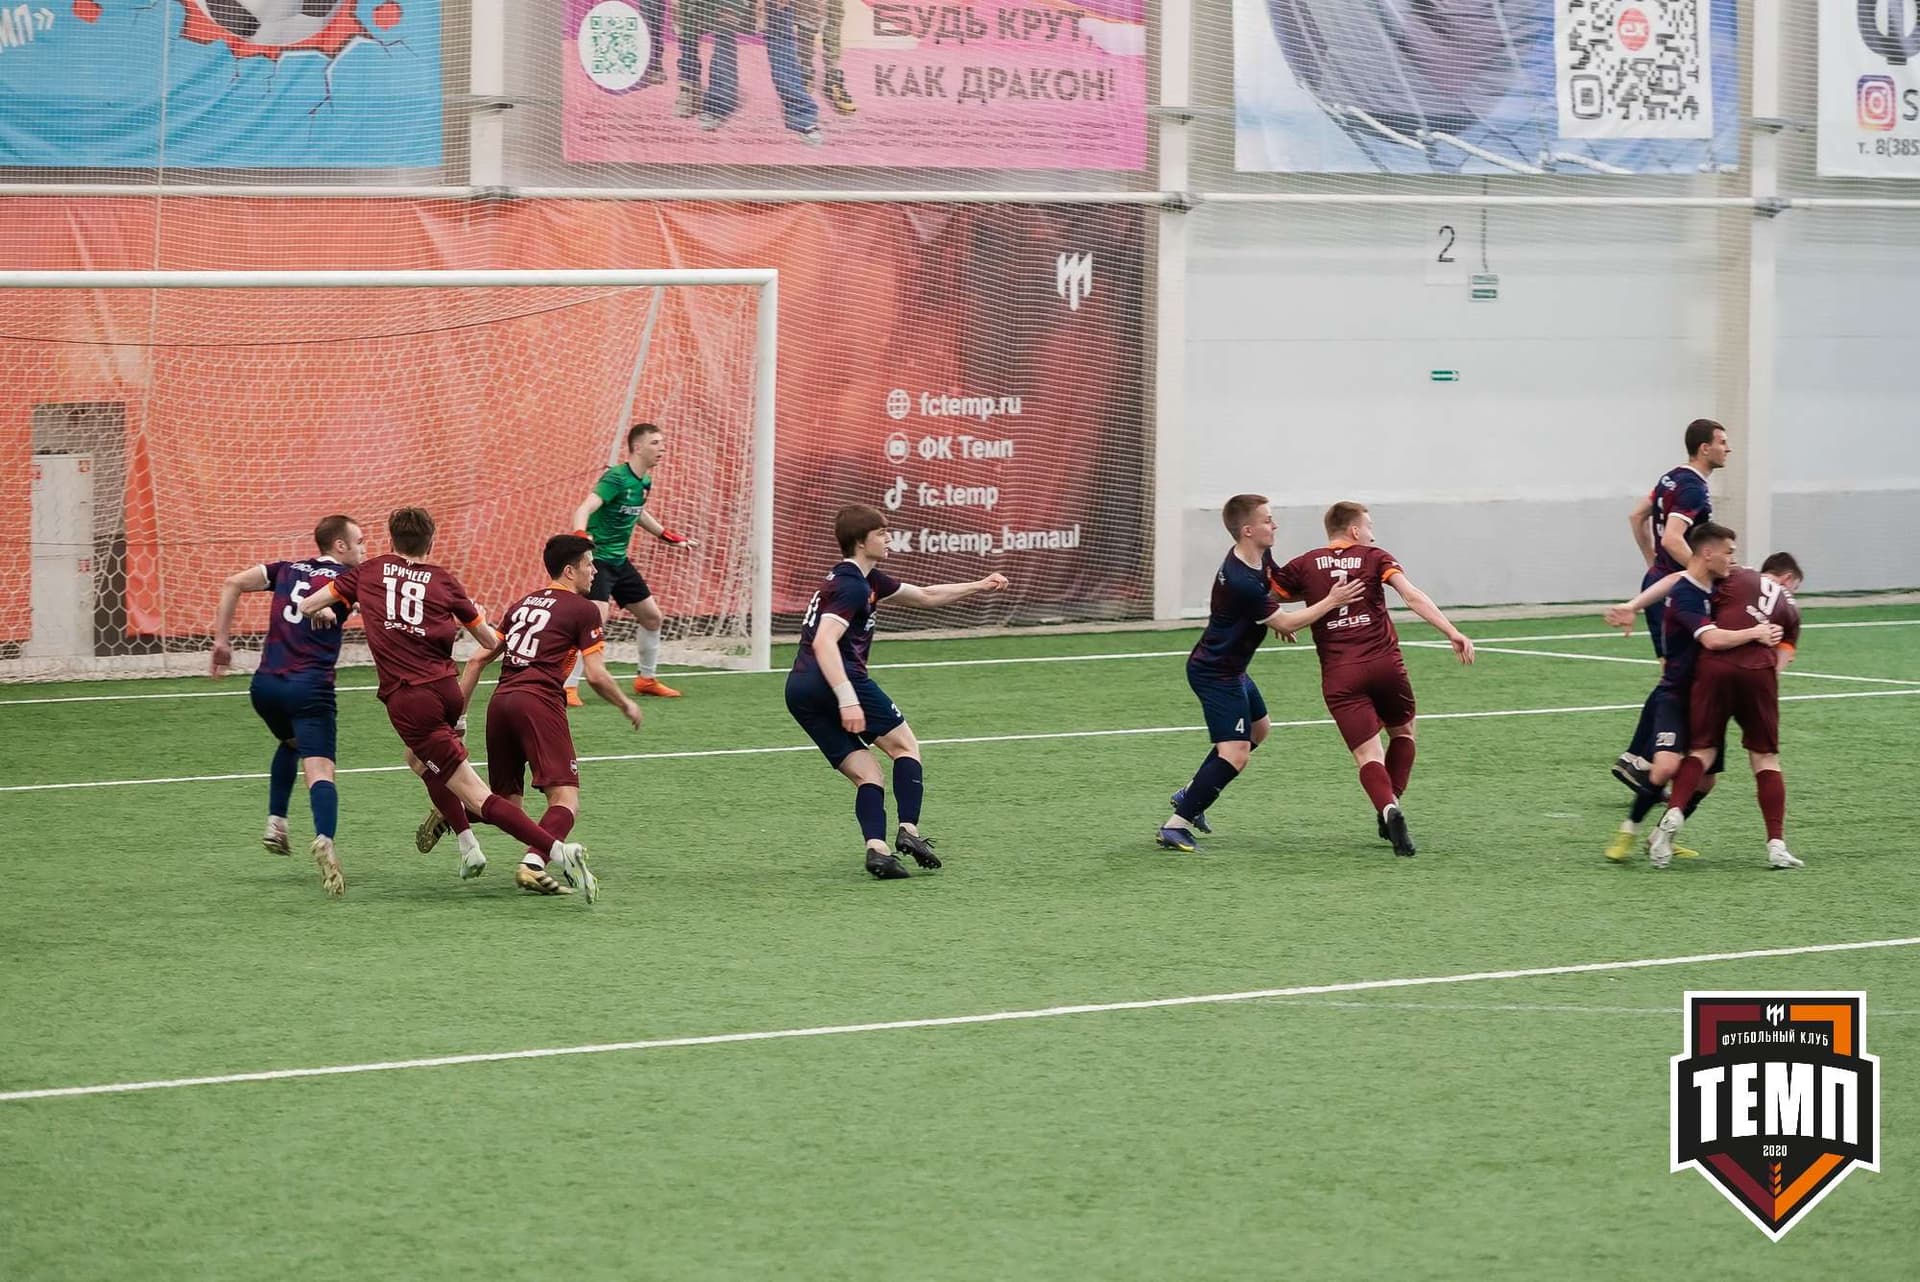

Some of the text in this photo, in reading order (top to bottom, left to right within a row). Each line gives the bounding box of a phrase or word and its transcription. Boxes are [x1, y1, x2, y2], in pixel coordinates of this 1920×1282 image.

[873, 3, 1094, 47] БУДЬ КРУТ,
[874, 63, 1115, 104] КАК ДРАКОН!
[1437, 225, 1456, 263] 2
[919, 391, 1022, 422] fctemp.ru
[918, 435, 1014, 460] ФК Темп
[918, 481, 999, 511] fc.temp
[919, 523, 1080, 557] fctemp_barnaul
[383, 563, 432, 584] БРИЧЕЕВ
[1315, 555, 1362, 570] ТАРАСОВ
[283, 580, 312, 624] 5
[383, 577, 426, 626] 18
[1758, 576, 1783, 616] 9
[505, 606, 551, 658] 22
[1327, 614, 1372, 630] SEUS
[1234, 717, 1245, 734] 4
